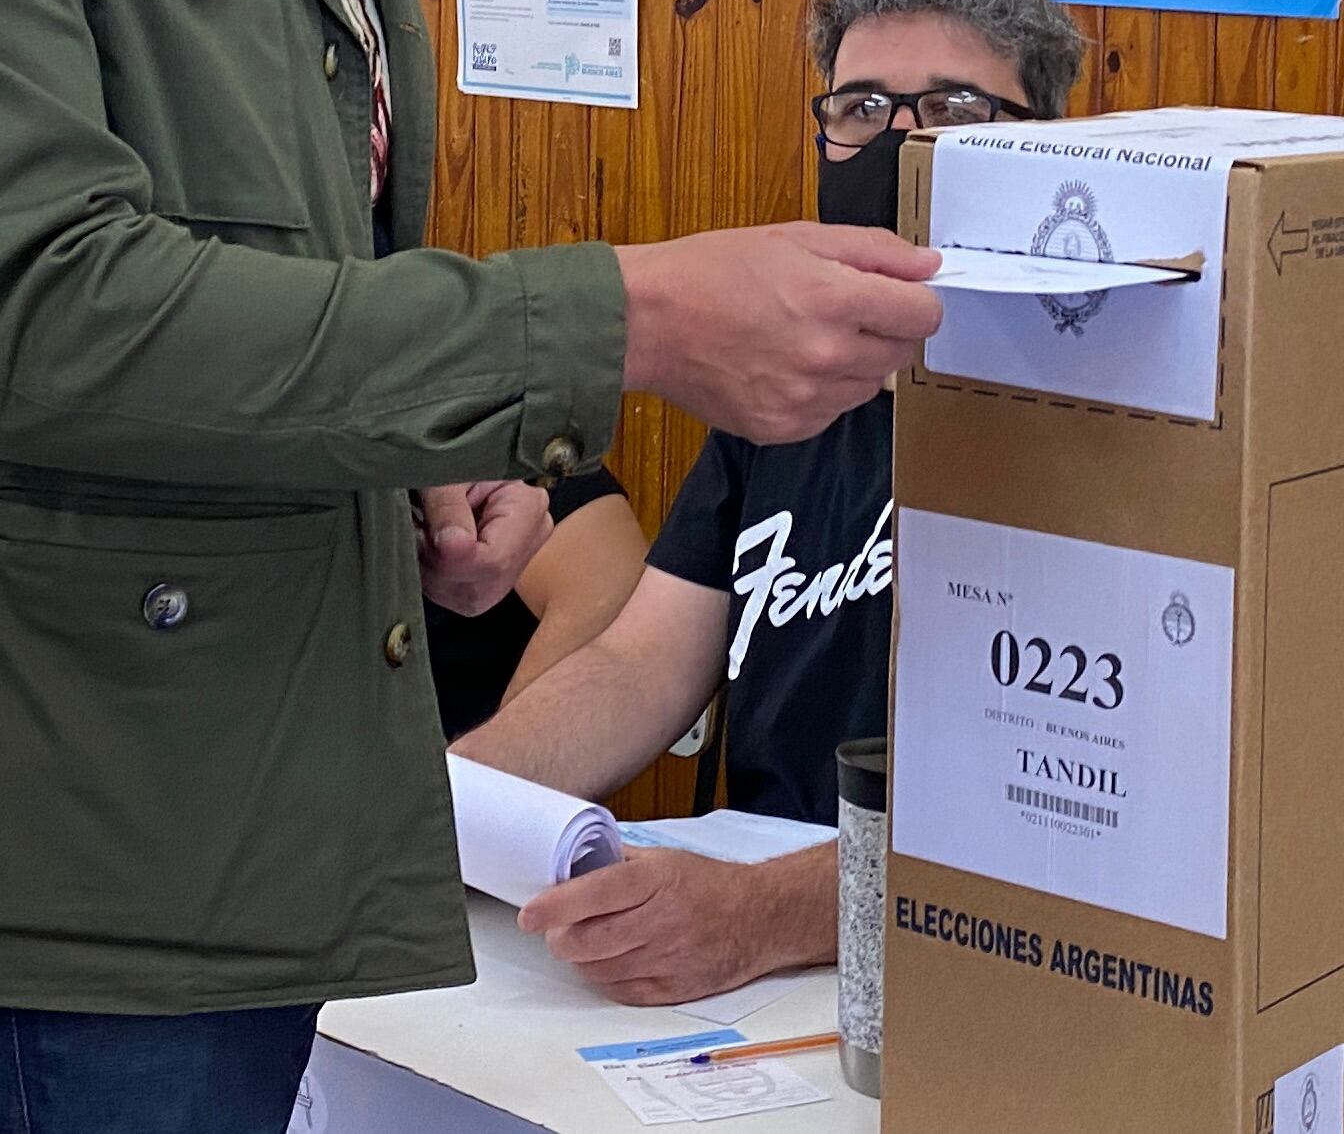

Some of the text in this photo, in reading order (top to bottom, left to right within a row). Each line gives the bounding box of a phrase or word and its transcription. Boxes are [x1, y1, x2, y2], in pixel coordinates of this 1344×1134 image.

[1019, 141, 1112, 161] Electoral
[1116, 149, 1212, 172] Nacional
[947, 581, 992, 604] MESA
[990, 630, 1124, 710] 0223
[984, 708, 1126, 751] DISTRITO BUENOS AIRES
[1016, 748, 1127, 798] TANDIL
[896, 896, 1214, 1017] ELECCIONES ARGENTINAS
